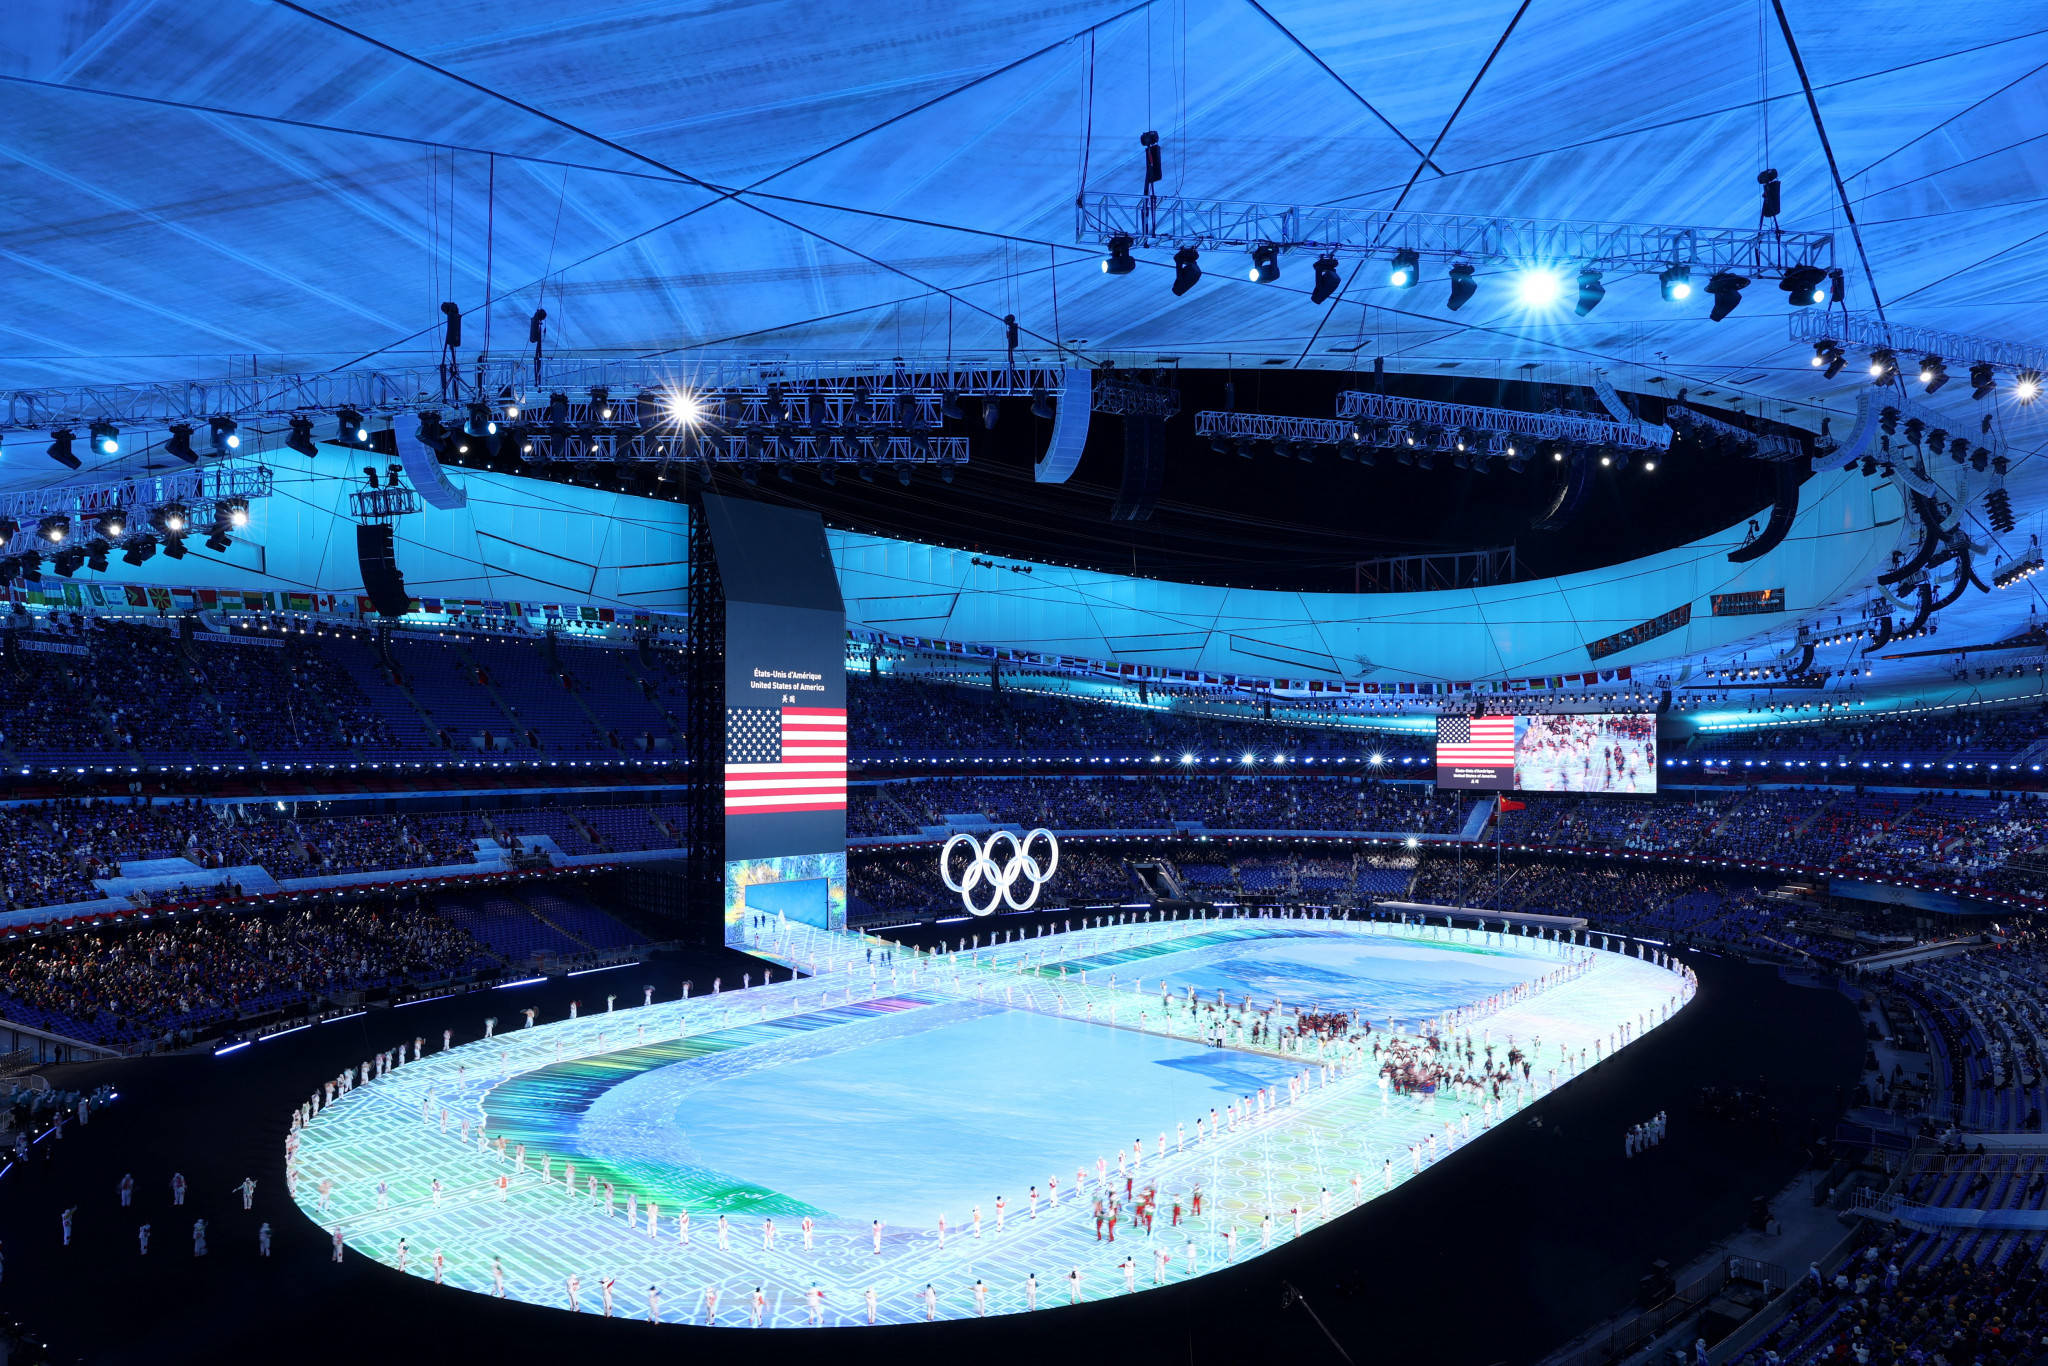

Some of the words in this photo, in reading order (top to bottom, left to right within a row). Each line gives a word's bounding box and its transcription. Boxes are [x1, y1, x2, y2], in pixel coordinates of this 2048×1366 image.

[754, 668, 786, 678] États-Unis
[788, 671, 821, 681] d'Amérique
[800, 683, 824, 691] America
